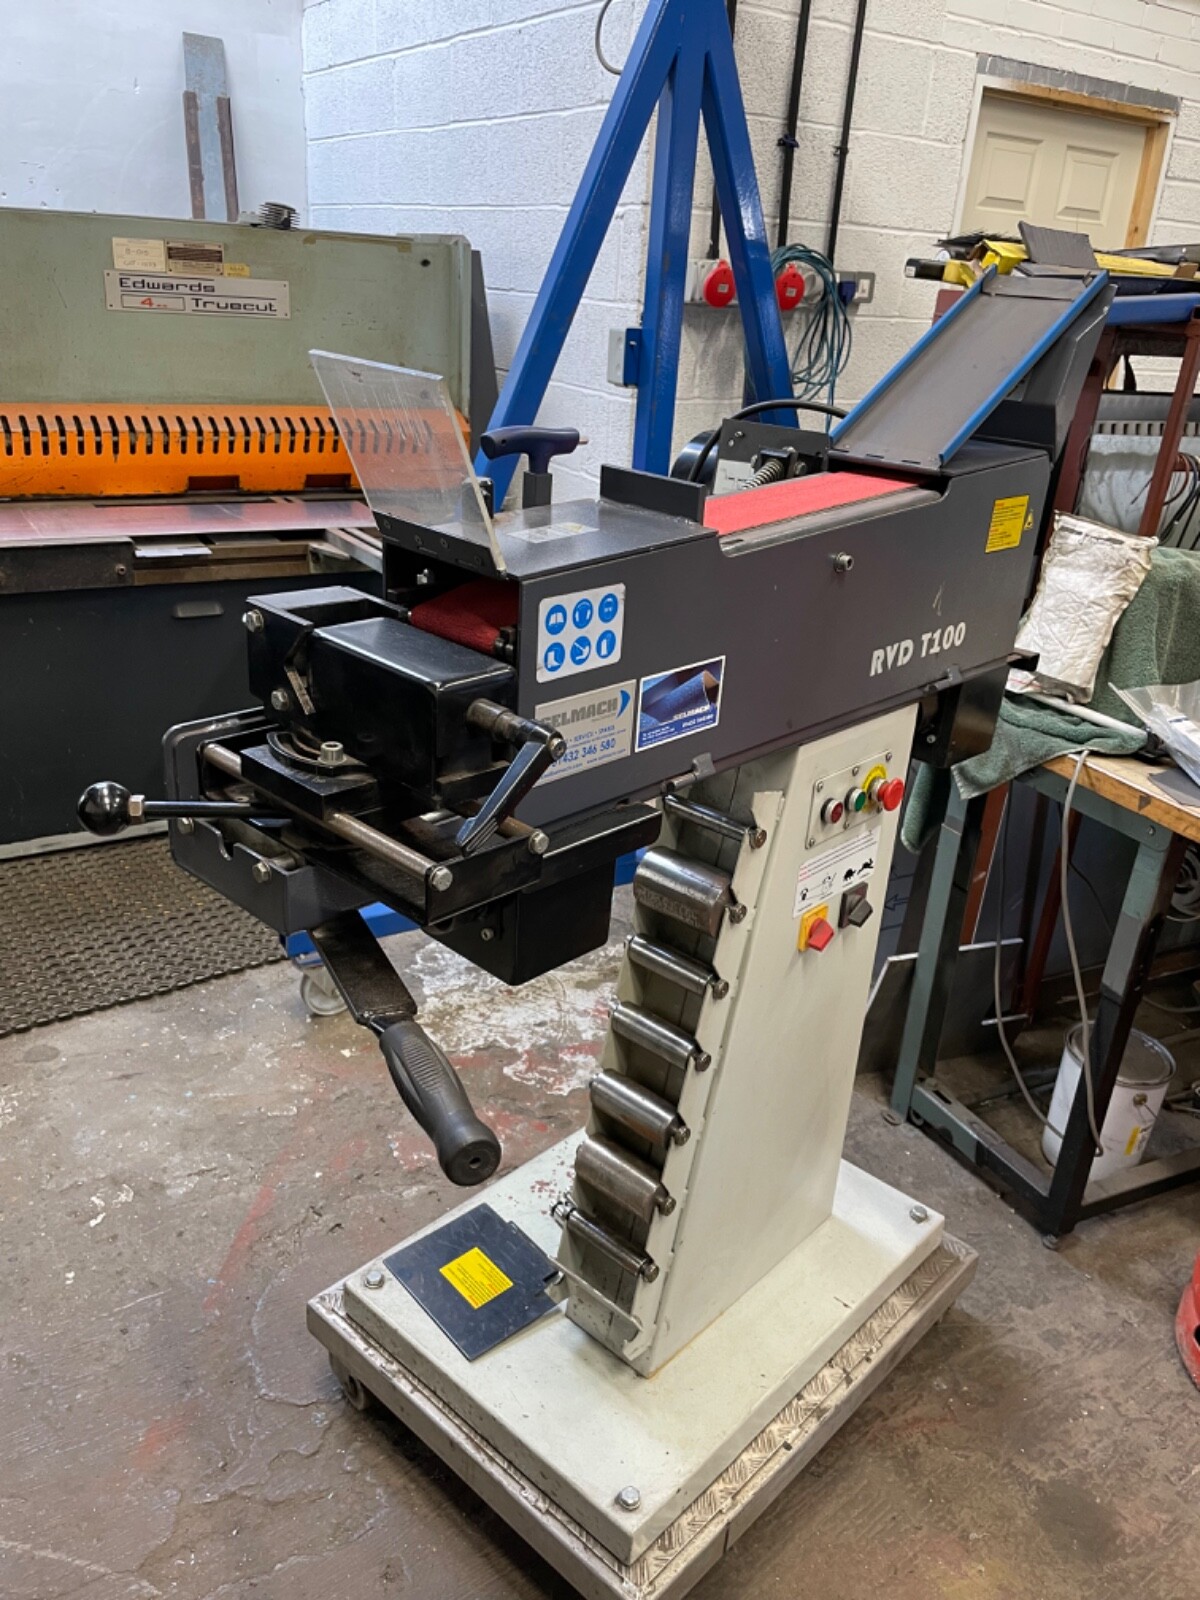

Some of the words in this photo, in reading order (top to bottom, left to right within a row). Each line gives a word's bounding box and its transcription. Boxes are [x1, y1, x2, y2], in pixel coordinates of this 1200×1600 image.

[119, 277, 215, 293] Edwards
[141, 297, 153, 307] 4
[191, 297, 277, 312] Truecut
[869, 639, 914, 677] RVD
[921, 622, 966, 657] T100
